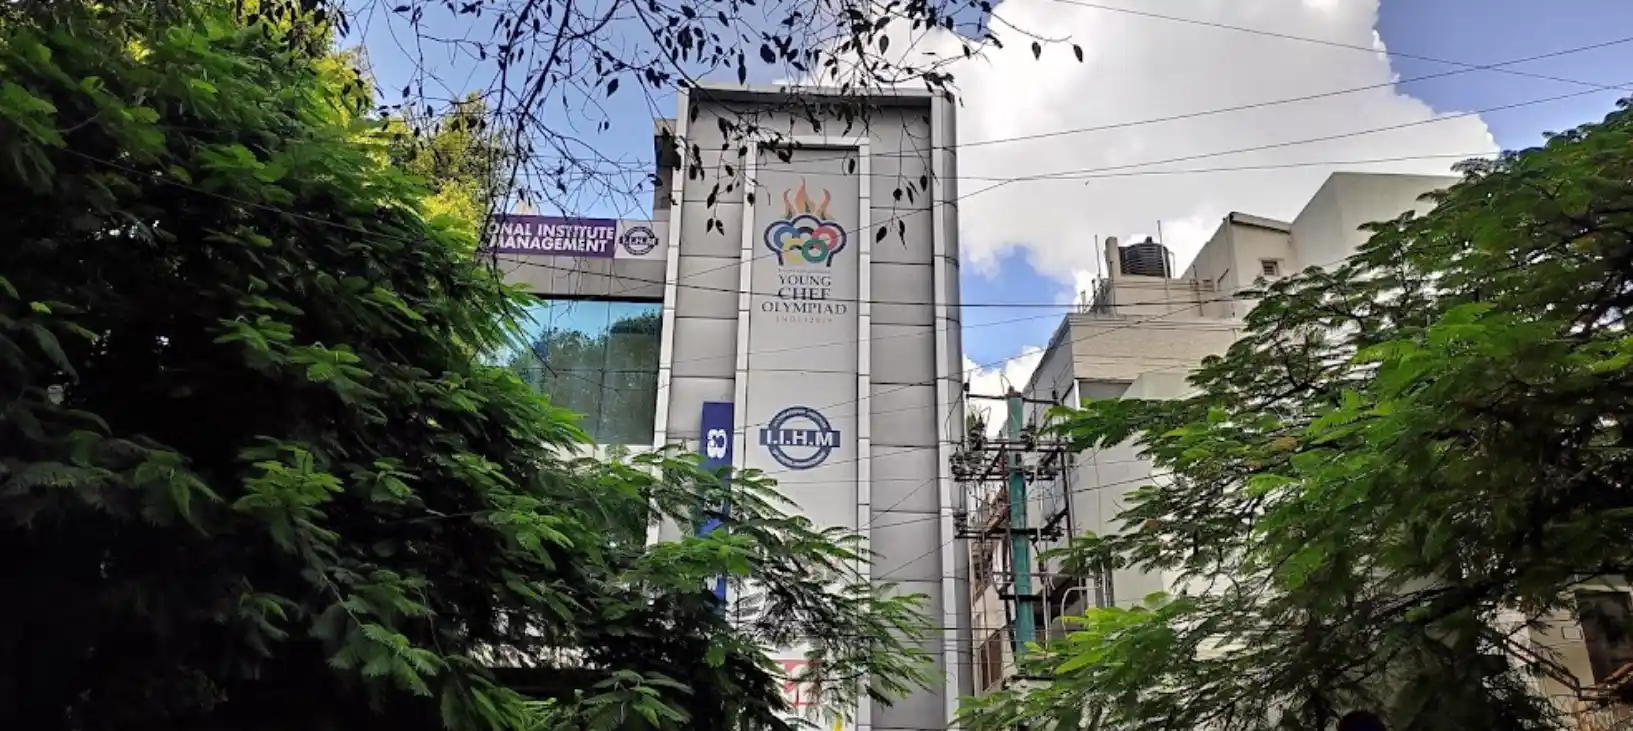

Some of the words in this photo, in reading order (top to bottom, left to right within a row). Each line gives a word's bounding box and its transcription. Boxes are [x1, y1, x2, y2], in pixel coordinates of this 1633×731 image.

[537, 224, 615, 240] INSTITUTE
[488, 234, 608, 253] MANAGEMENT
[778, 274, 832, 287] YOUNG
[778, 287, 832, 301] CHEF
[761, 301, 848, 316] OLYMPIAD
[766, 429, 833, 447] I.I.H.M
